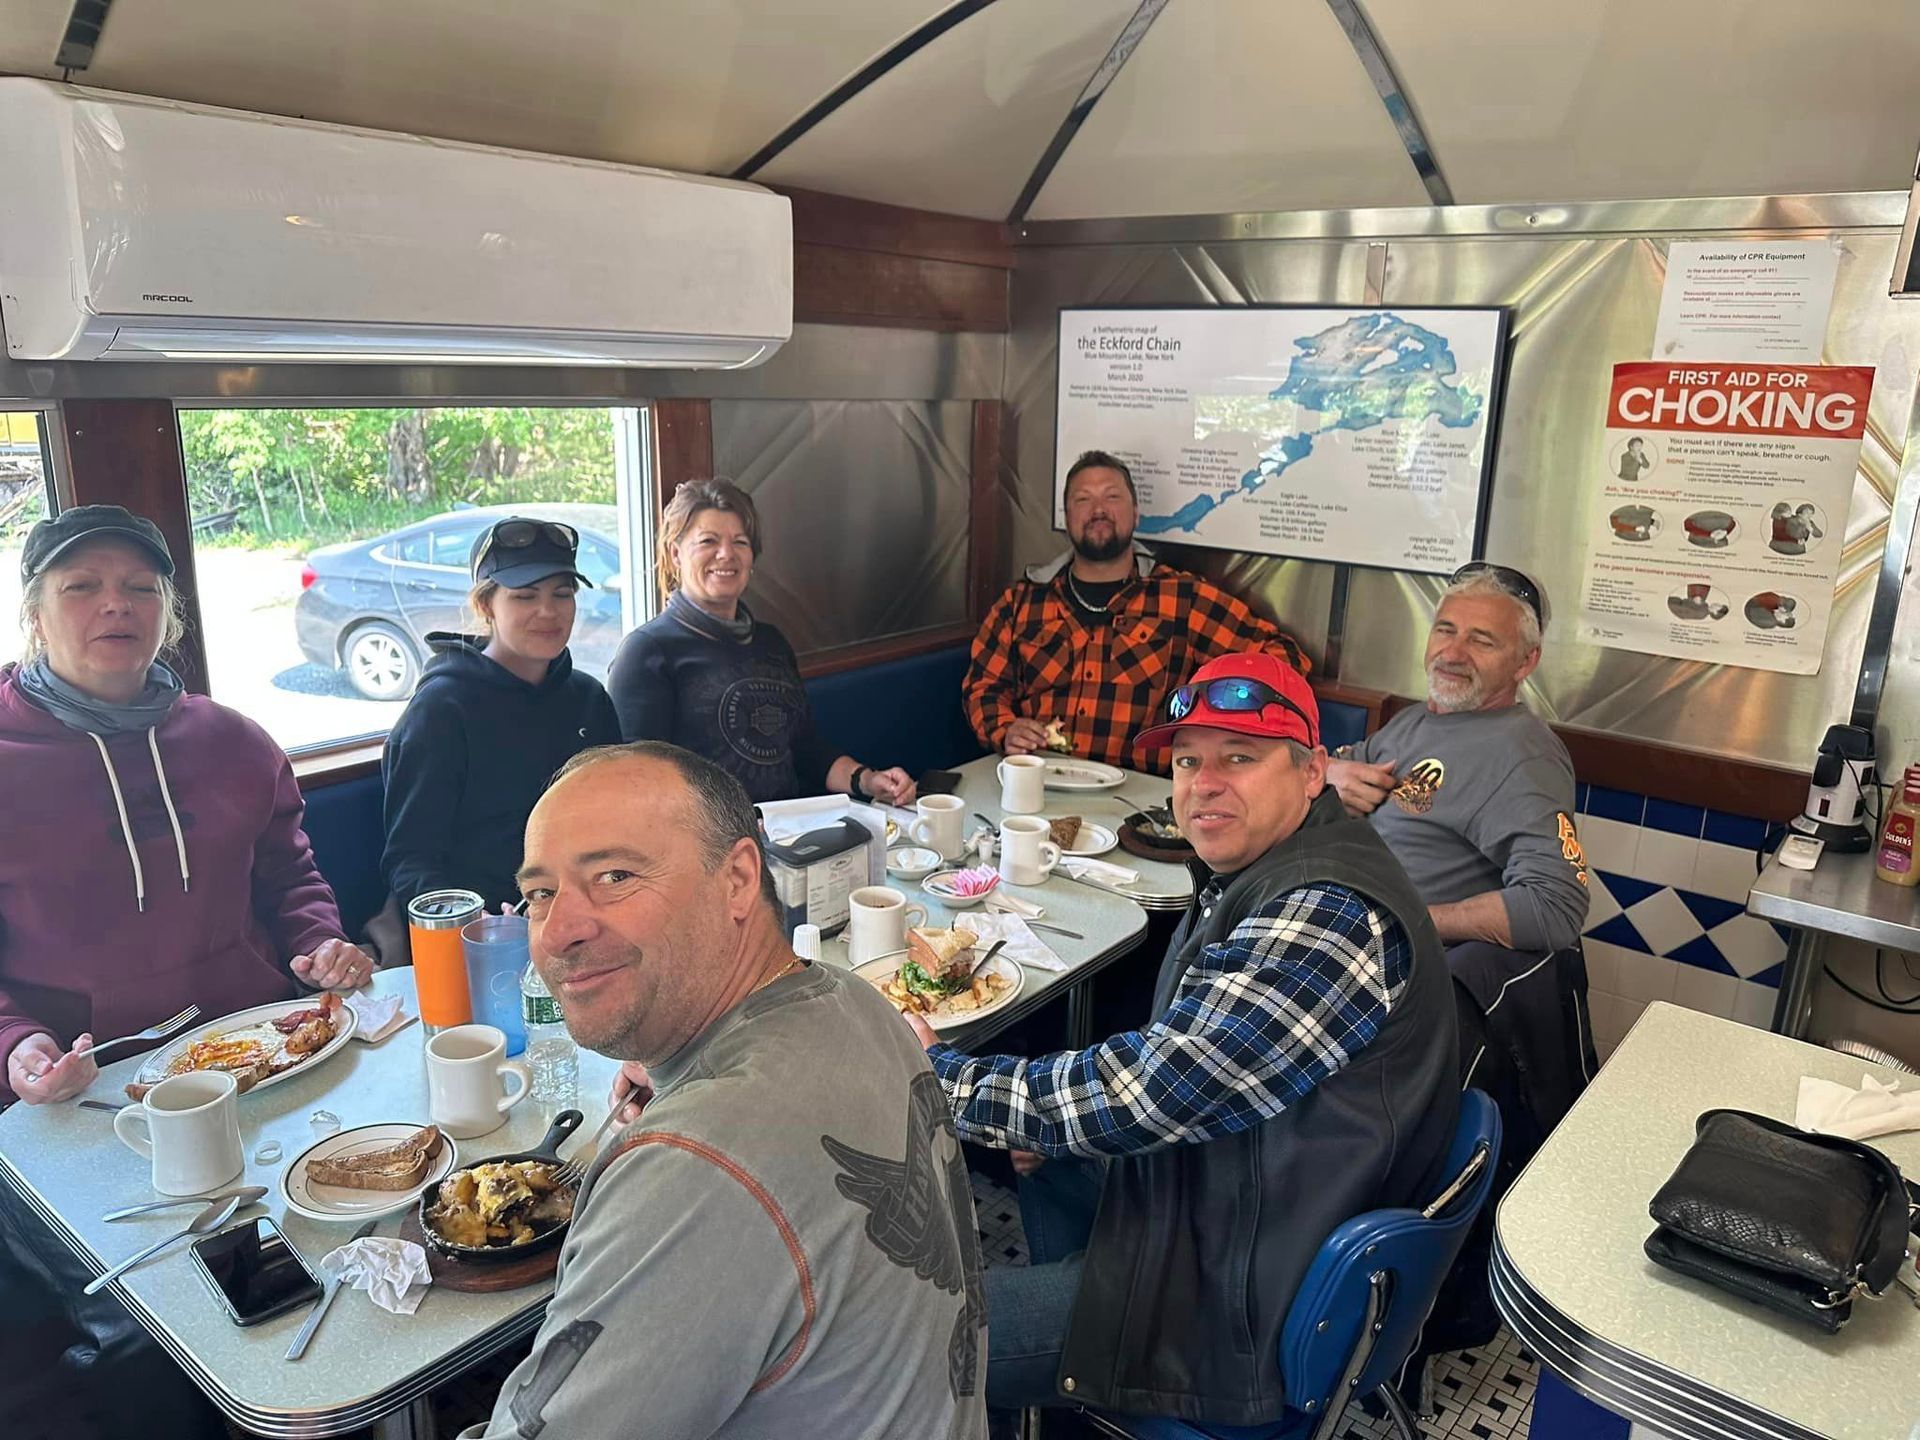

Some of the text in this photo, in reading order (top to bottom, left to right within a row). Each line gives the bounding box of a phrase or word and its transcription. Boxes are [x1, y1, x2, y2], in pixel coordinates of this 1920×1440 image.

[1699, 253, 1738, 261] Availability
[1765, 253, 1806, 261] Equipment
[143, 294, 192, 303] MRCOOL
[1078, 335, 1182, 351] the Eckford Chain
[1668, 370, 1808, 388] FIRST AID FOR
[1618, 387, 1857, 431] CHOKING
[1669, 437, 1683, 445] You
[1684, 438, 1703, 446] must
[1723, 439, 1744, 447] there
[1759, 442, 1774, 451] any
[1775, 442, 1796, 451] signs
[1690, 448, 1715, 457] person
[1716, 448, 1735, 456] can't
[1736, 449, 1761, 458] speak,
[1763, 451, 1793, 460] breathe
[1804, 453, 1832, 462] cough.
